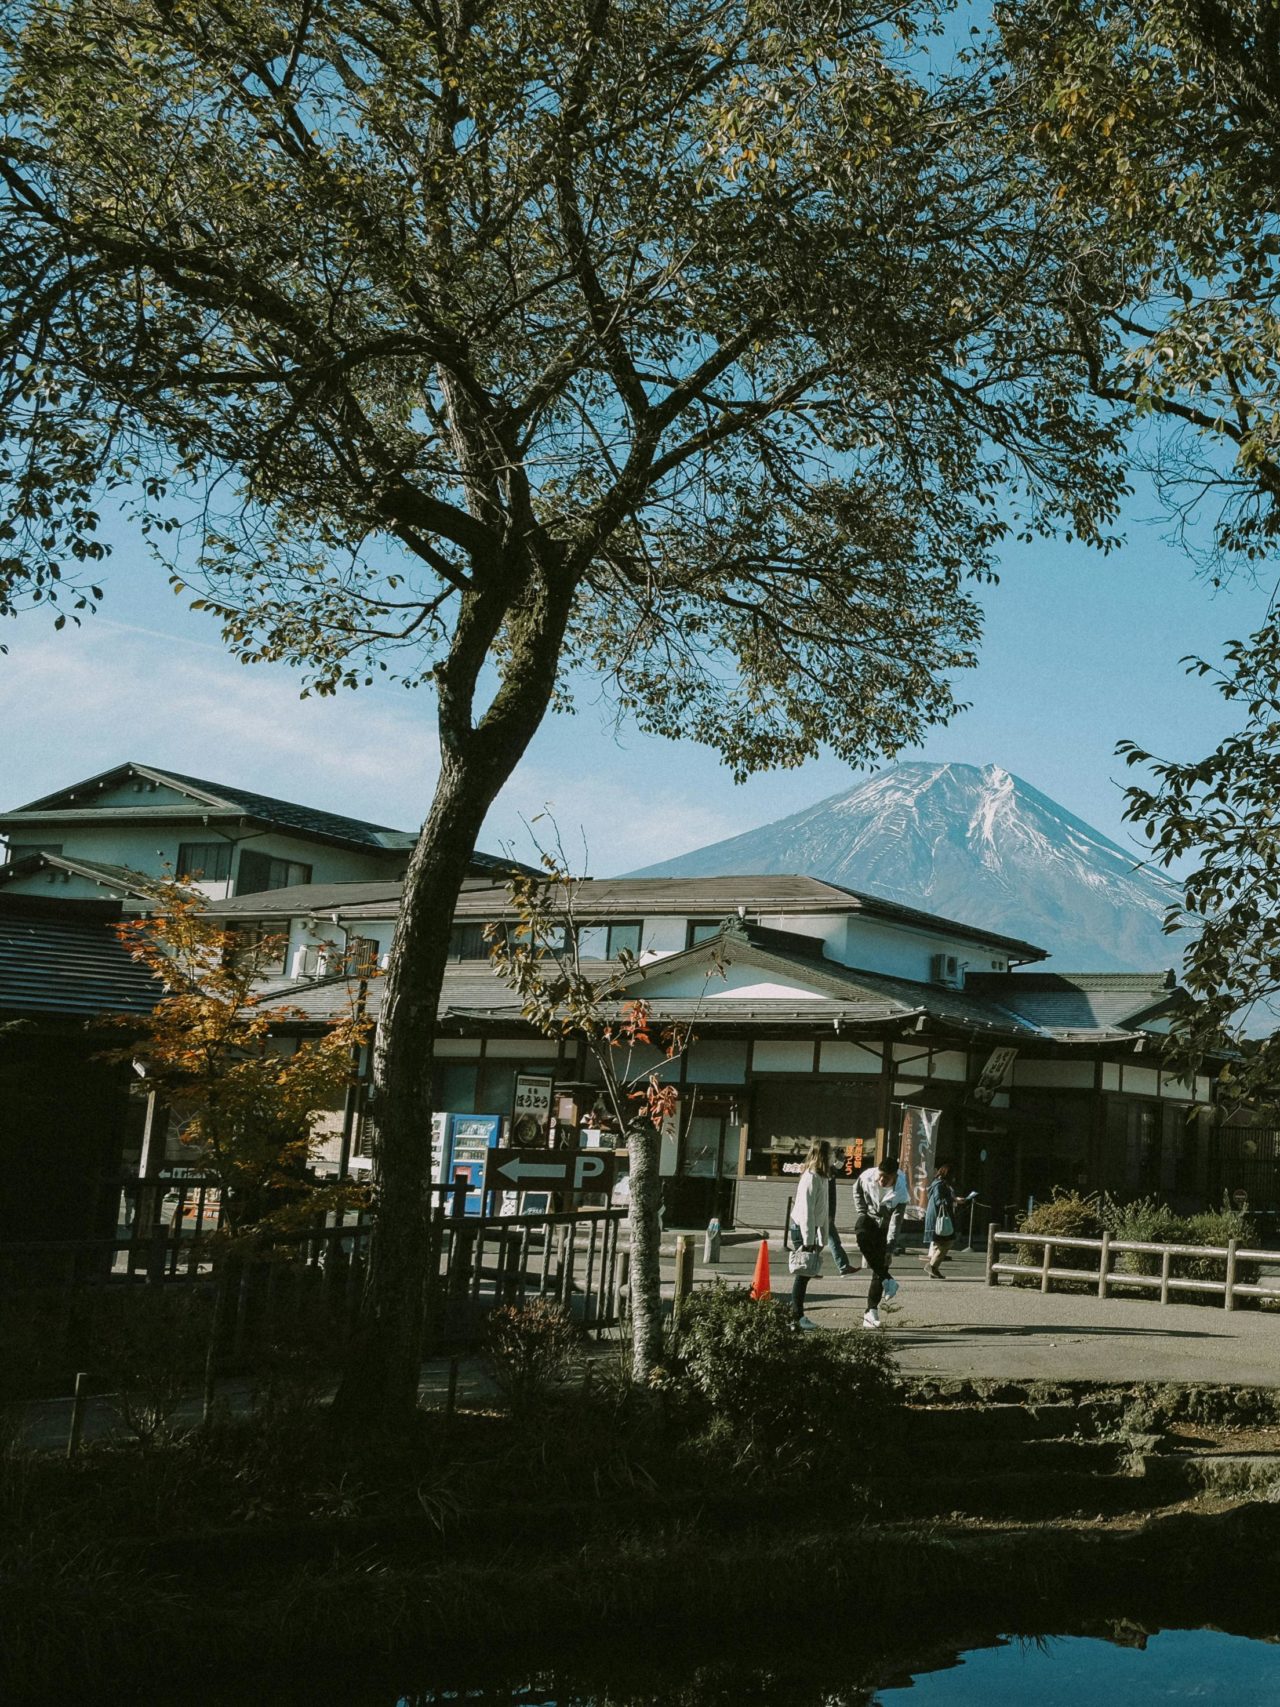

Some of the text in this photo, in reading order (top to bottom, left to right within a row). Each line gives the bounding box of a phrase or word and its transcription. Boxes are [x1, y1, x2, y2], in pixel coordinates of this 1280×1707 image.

[517, 1095, 549, 1108] ほうとう
[573, 1156, 605, 1189] P
